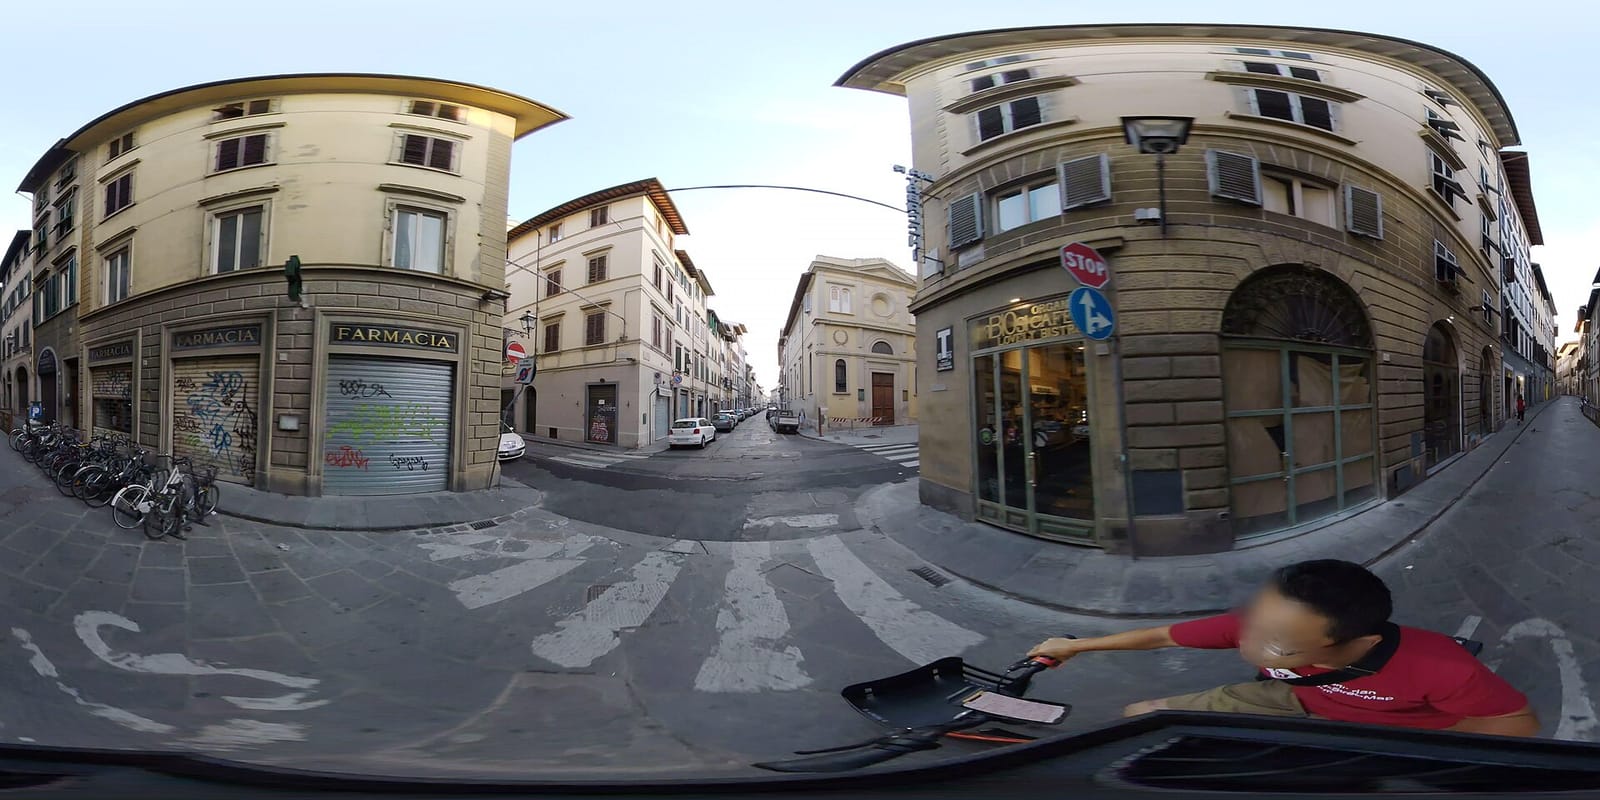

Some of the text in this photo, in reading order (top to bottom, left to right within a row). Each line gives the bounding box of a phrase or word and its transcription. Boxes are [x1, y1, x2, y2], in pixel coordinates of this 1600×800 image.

[1065, 252, 1105, 276] STOP
[176, 329, 254, 347] FARMACIA
[337, 327, 451, 348] FARMACIA
